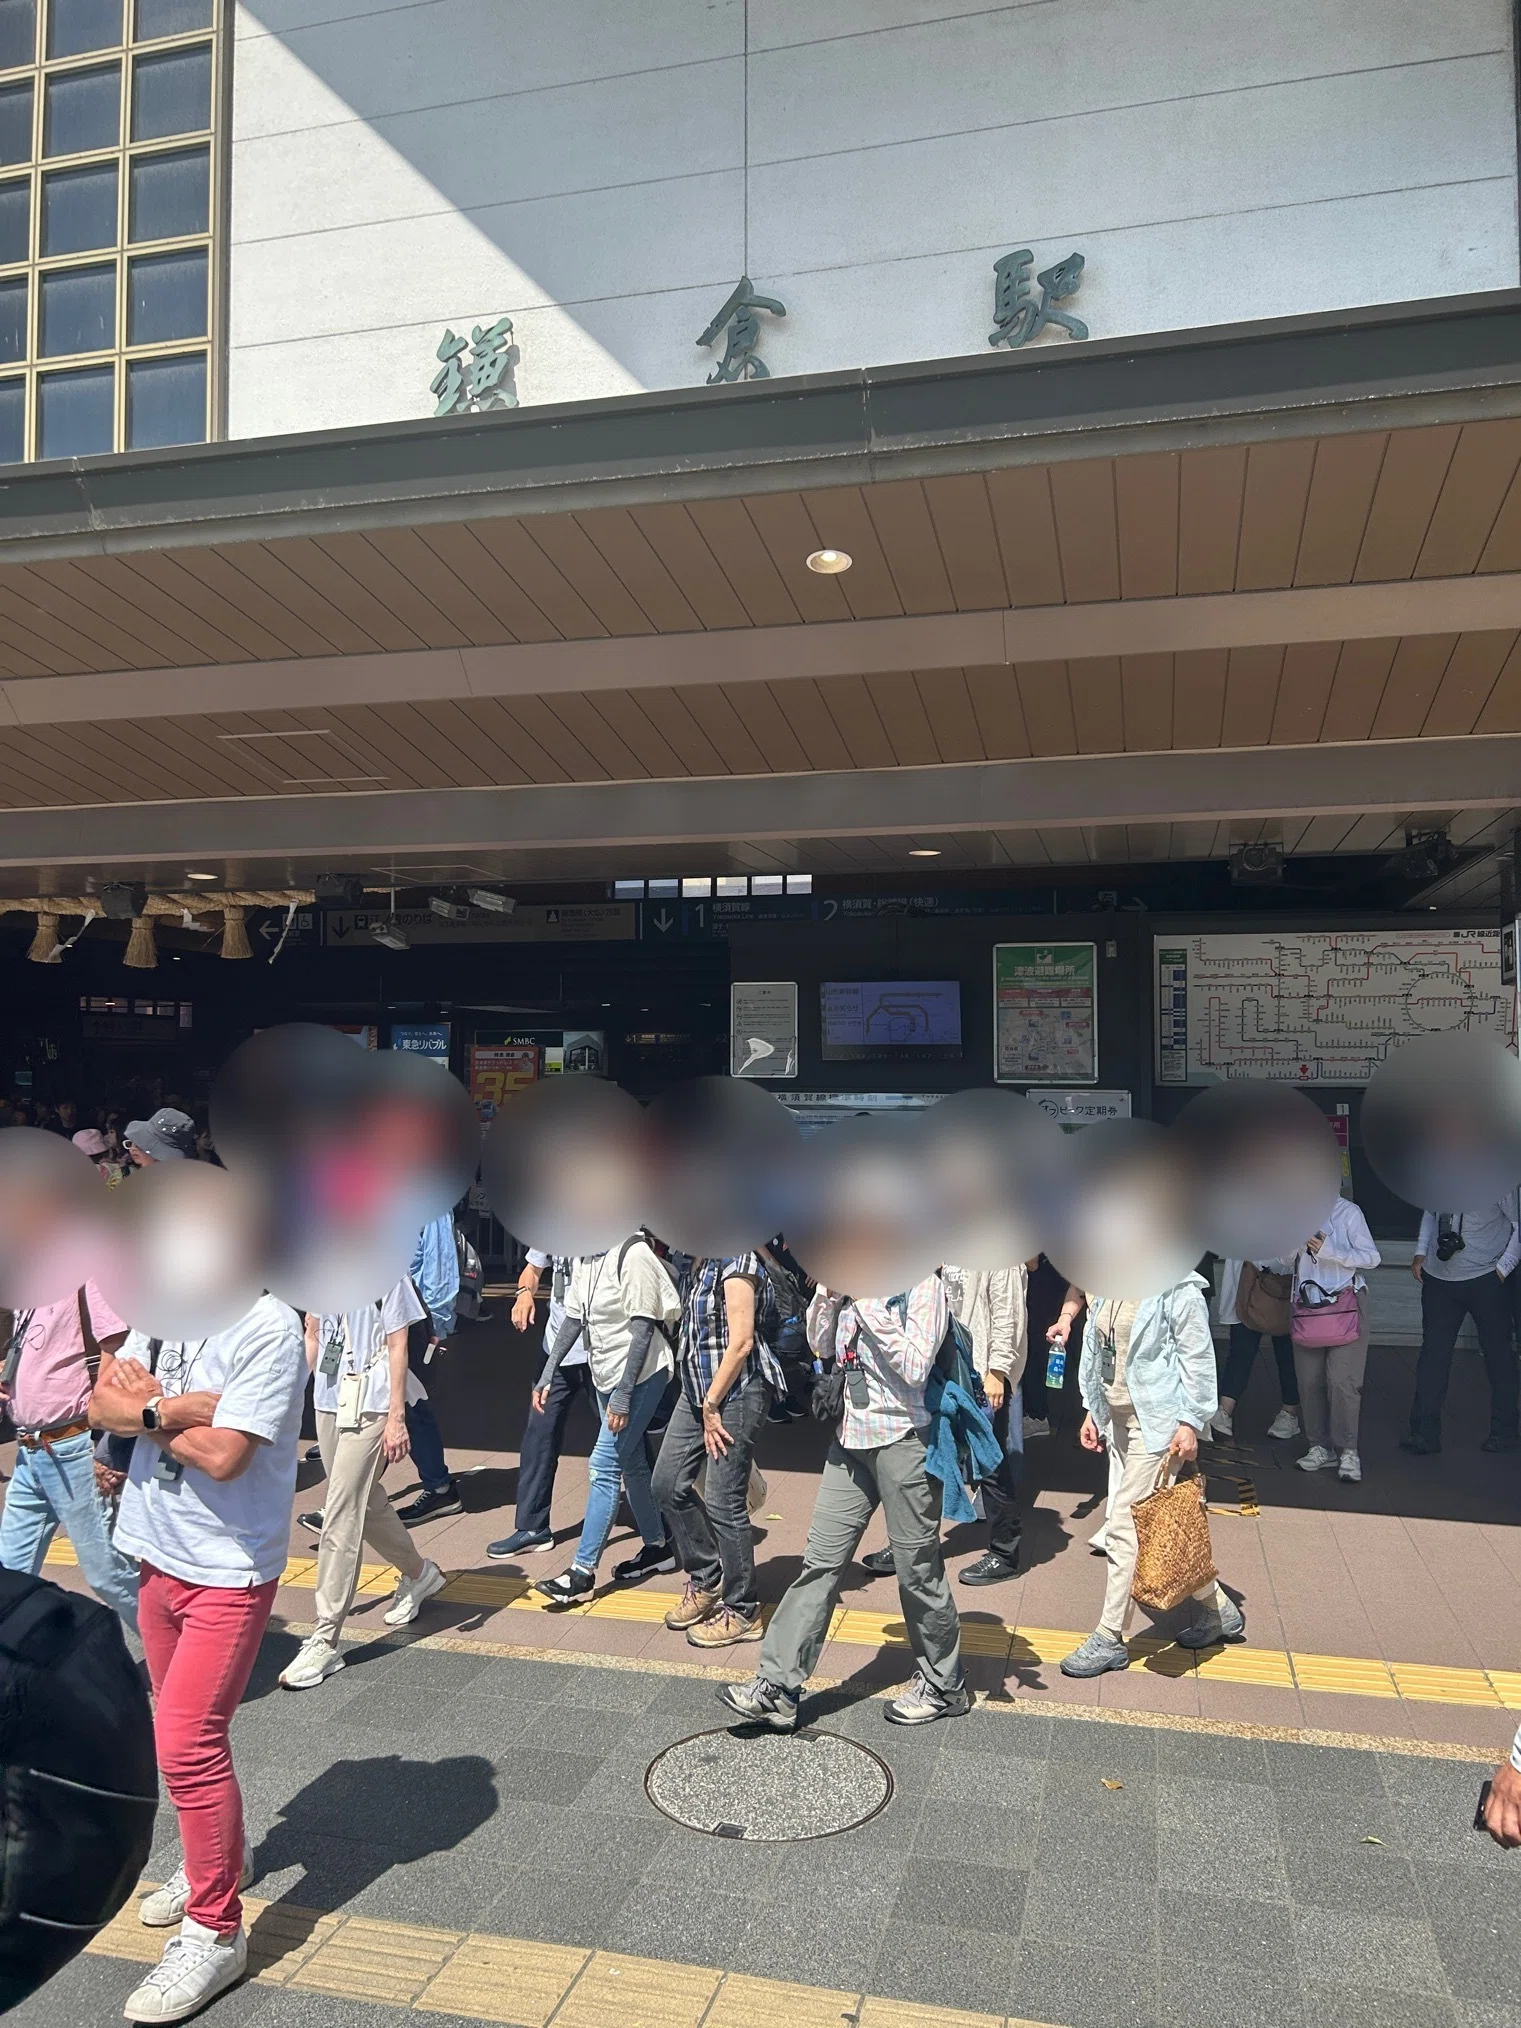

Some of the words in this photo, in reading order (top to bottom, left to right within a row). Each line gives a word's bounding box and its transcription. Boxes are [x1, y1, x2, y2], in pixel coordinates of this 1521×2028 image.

[712, 902, 751, 913] 横須賀線
[823, 900, 838, 921] 2
[695, 903, 705, 928] 1
[1014, 965, 1075, 977] 津波避難場所
[402, 1039, 447, 1050] 東急リバブル
[512, 1037, 536, 1045] SMBC
